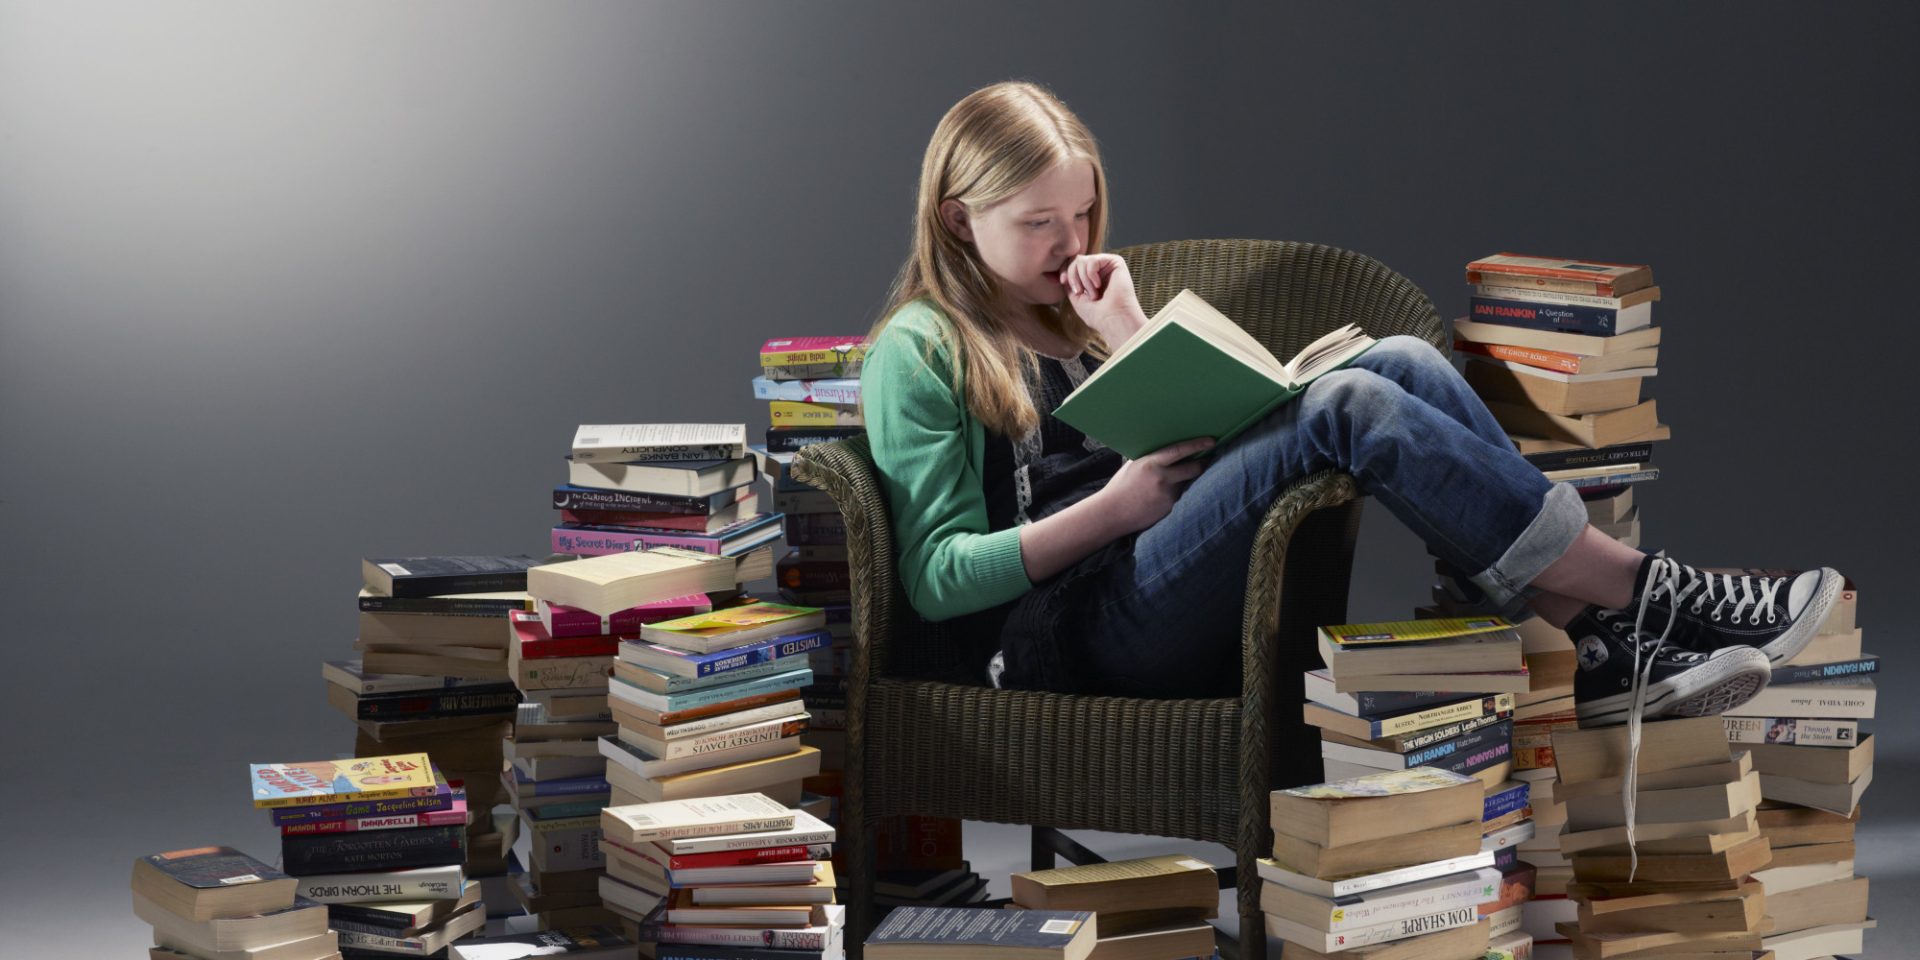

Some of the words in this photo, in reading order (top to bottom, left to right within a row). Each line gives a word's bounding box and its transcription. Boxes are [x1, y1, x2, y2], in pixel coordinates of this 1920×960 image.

[1475, 304, 1494, 315] IAN
[1495, 306, 1536, 319] RANKIN
[1545, 309, 1574, 319] Question
[1553, 316, 1560, 324] of
[1496, 347, 1508, 355] THE
[1509, 349, 1529, 359] GHOST
[1530, 353, 1549, 362] ROAD
[621, 446, 689, 455] COMPLICITY
[1608, 452, 1629, 460] CAREY
[640, 453, 678, 461] BANKS
[783, 636, 822, 655] TWISTED
[1824, 662, 1858, 675] RANKIN
[1858, 661, 1875, 671] IAN
[1811, 669, 1821, 677] The
[440, 695, 460, 710] ARK
[1817, 699, 1840, 707] VIDAL
[1843, 699, 1864, 707] GORE
[766, 725, 780, 734] THE
[1722, 719, 1760, 731] UREEN
[1804, 725, 1831, 734] Through
[739, 727, 765, 738] COURSE
[1403, 740, 1413, 752] THE
[1414, 735, 1433, 748] VIRGIN
[1434, 726, 1460, 743] SOLDIERS
[1461, 719, 1477, 731] Leslie
[1477, 714, 1497, 727] Thomas
[1727, 731, 1742, 741] EE
[1812, 733, 1833, 741] Storm
[729, 731, 779, 747] LINDSEY
[692, 741, 727, 753] DAVIS
[1495, 743, 1509, 756] IAN
[1408, 754, 1424, 767] IAN
[1424, 743, 1457, 763] RANKIN
[1466, 747, 1495, 768] RANKIN
[310, 810, 321, 818] The
[346, 803, 370, 814] Game
[376, 801, 416, 813] Jacqueline
[417, 798, 441, 808] Wilson
[287, 823, 316, 833] AMANDA
[320, 821, 342, 830] SWIFT
[726, 824, 738, 832] THE
[742, 821, 762, 831] AMIS
[763, 819, 793, 830] MARTIN
[809, 833, 829, 841] ANITA
[312, 845, 328, 855] THE
[335, 838, 392, 852] FORGOTTEN
[393, 835, 434, 848] GARDEN
[344, 854, 365, 863] KATE
[368, 852, 402, 861] MORTON
[309, 887, 340, 897] BIRDS
[341, 885, 380, 896] THORN
[381, 884, 403, 895] THE
[1423, 895, 1434, 905] The
[1449, 907, 1474, 926] TOM
[1402, 911, 1446, 934] SHARPE
